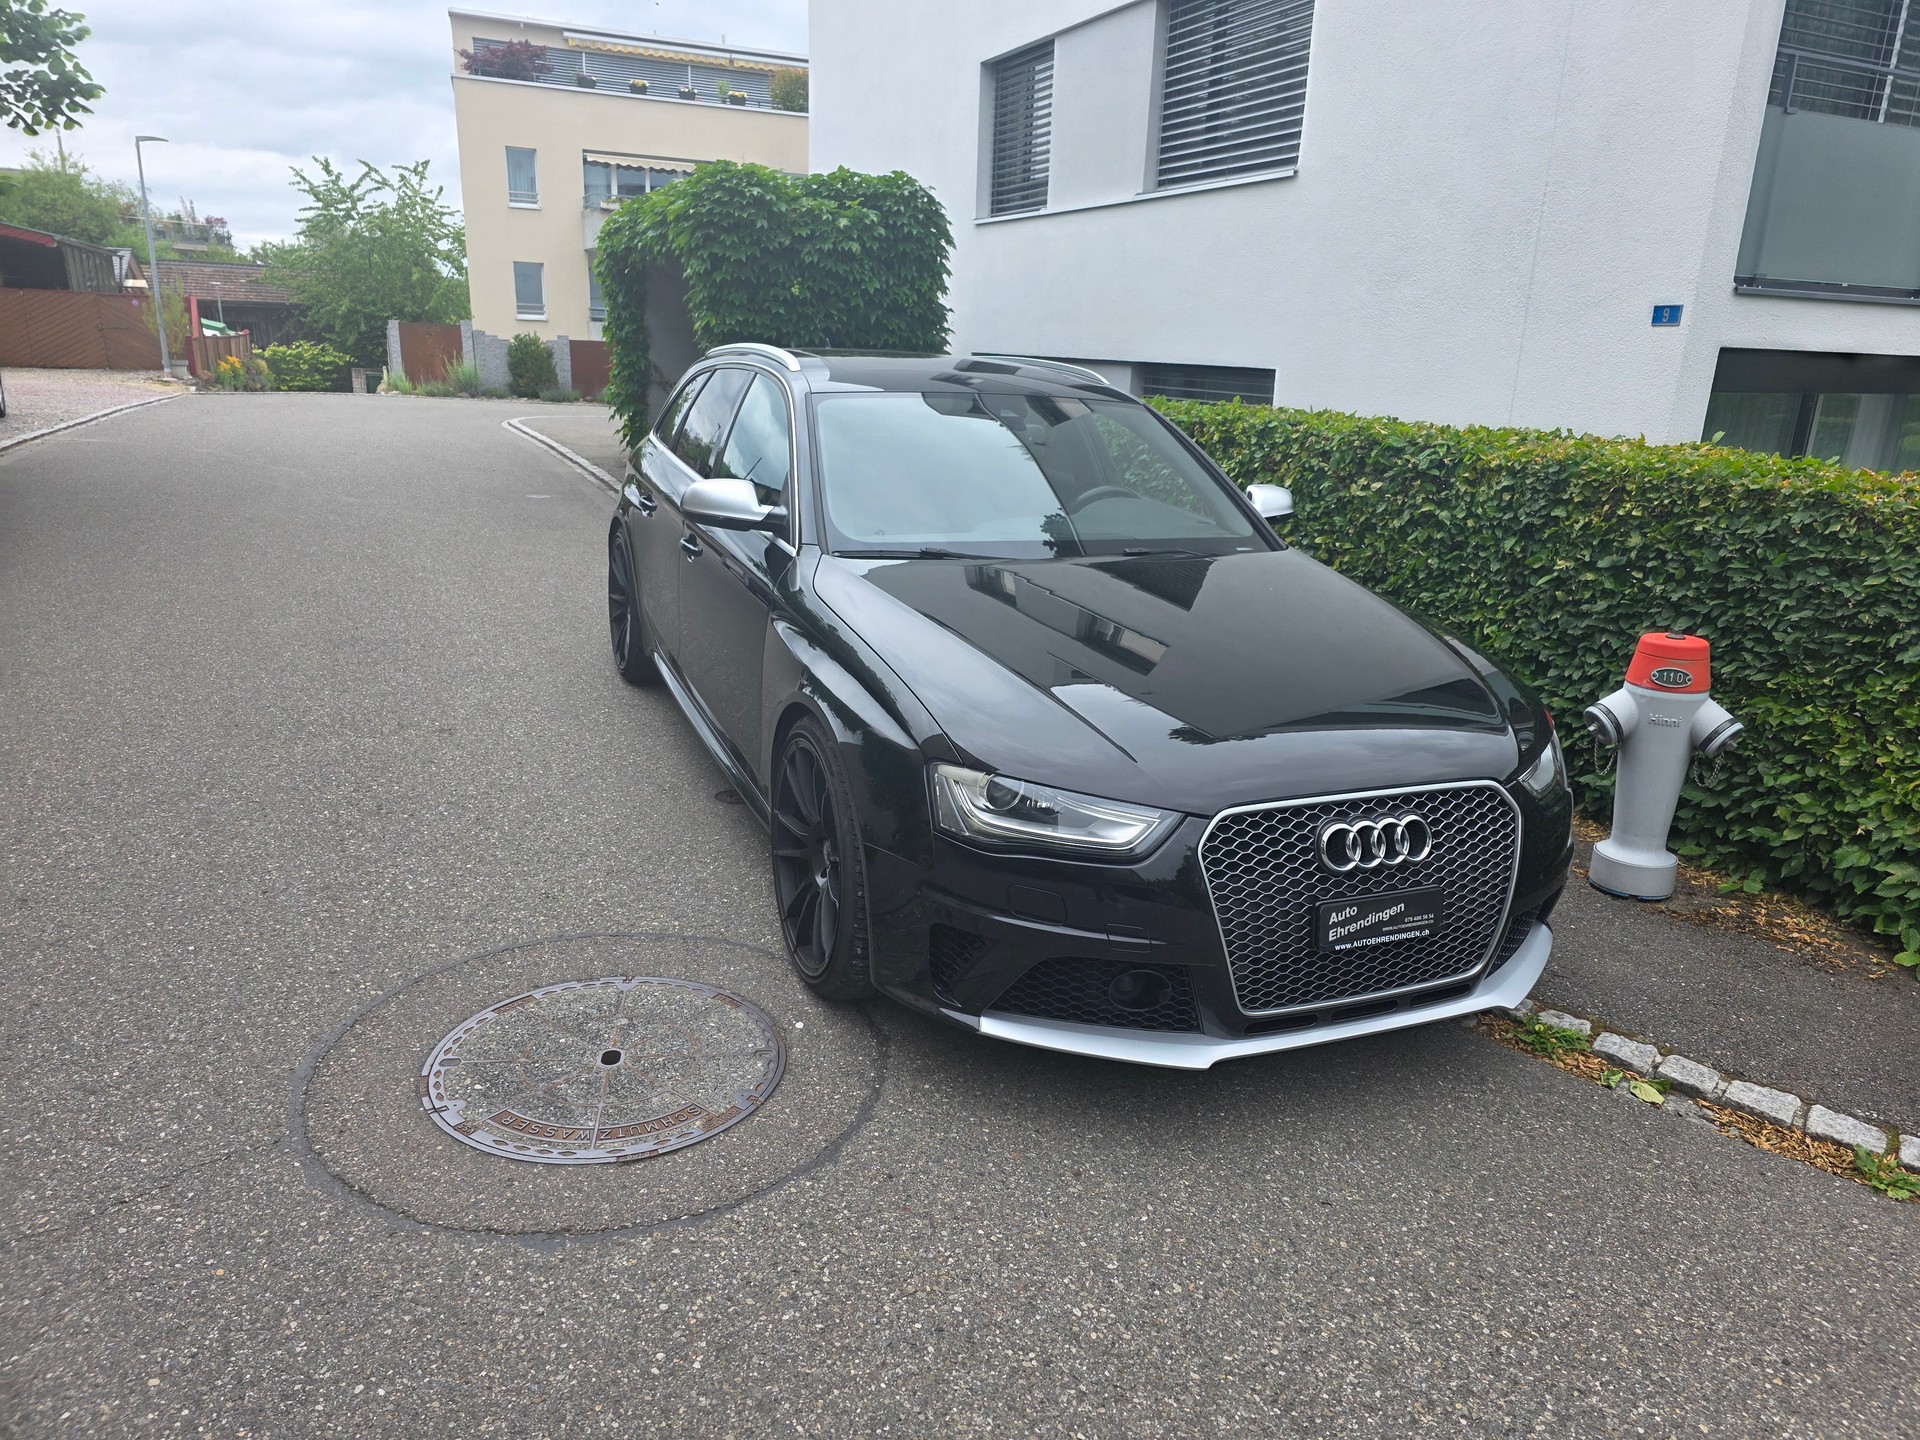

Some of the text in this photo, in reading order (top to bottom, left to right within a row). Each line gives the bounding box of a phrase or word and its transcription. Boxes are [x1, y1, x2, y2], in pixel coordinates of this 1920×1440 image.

[1662, 307, 1670, 322] 9
[1663, 672, 1683, 683] 110
[1648, 713, 1682, 727] Hinni
[1328, 906, 1358, 925] Auto
[1328, 903, 1405, 941] Ehrendingen
[1334, 928, 1430, 951] www.AUTOEHRENDINGEN.ch
